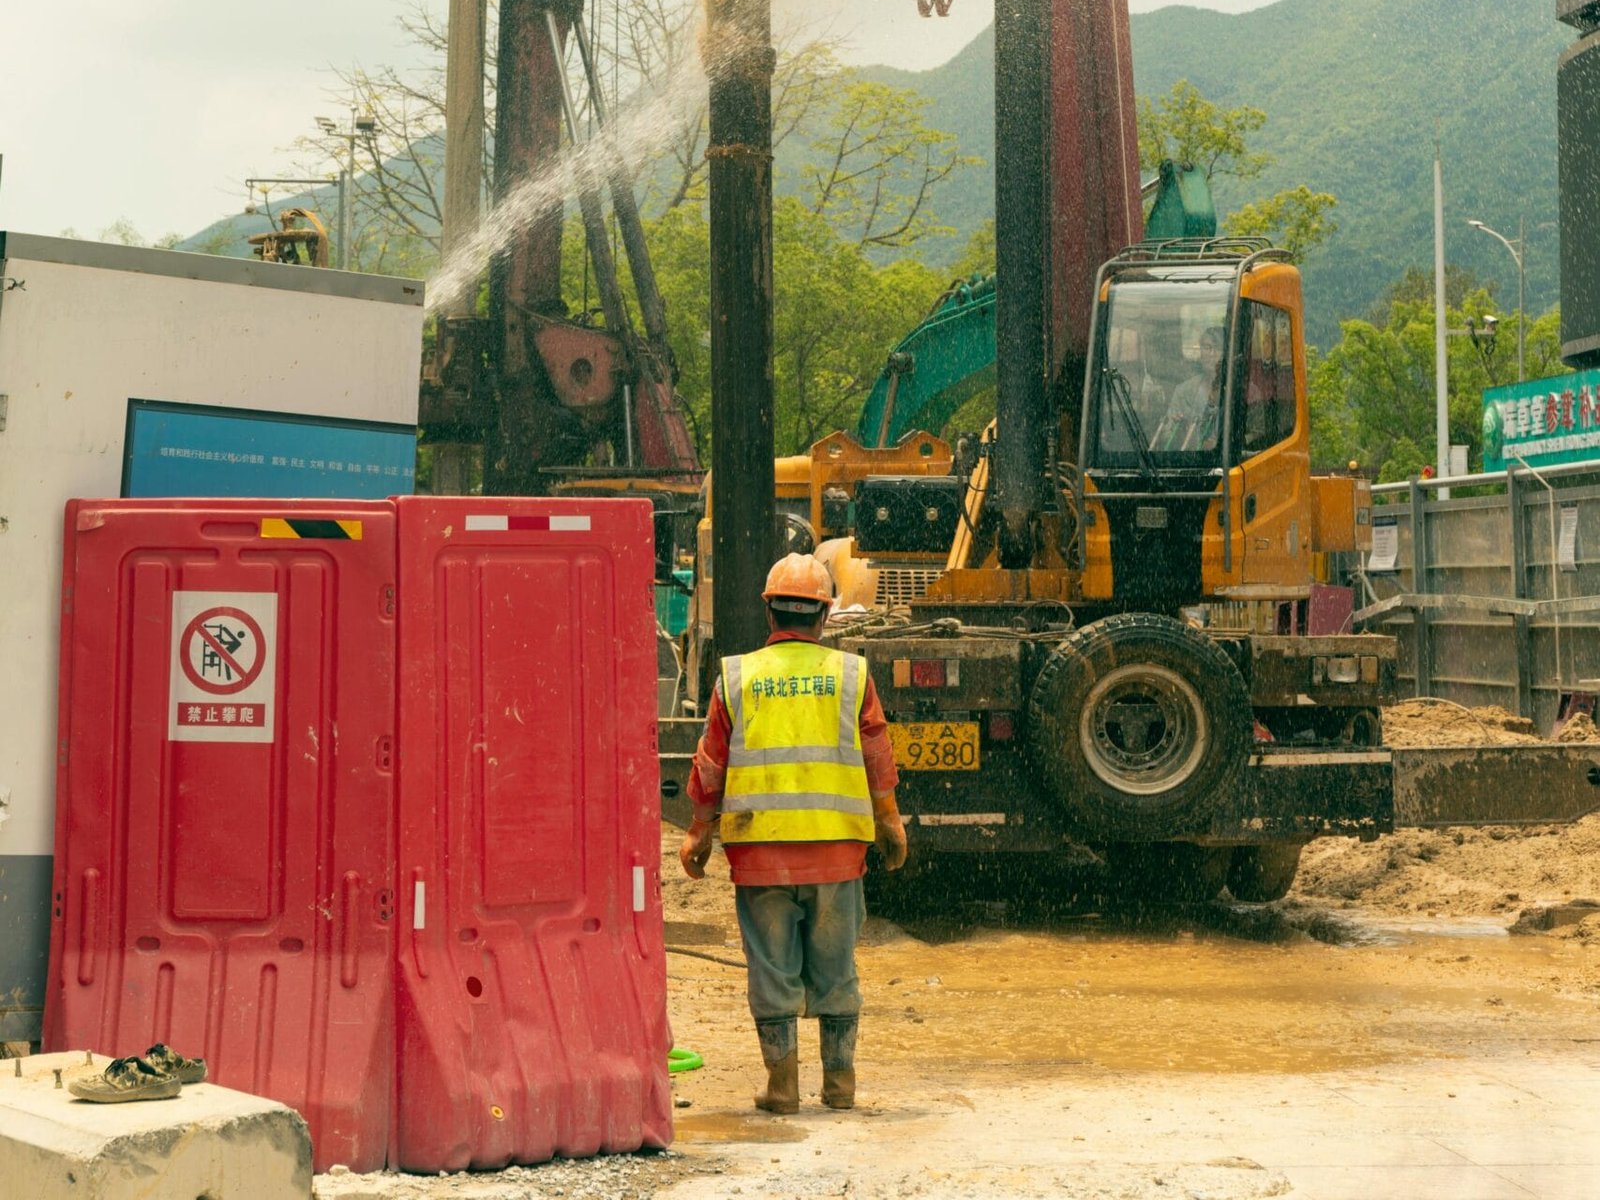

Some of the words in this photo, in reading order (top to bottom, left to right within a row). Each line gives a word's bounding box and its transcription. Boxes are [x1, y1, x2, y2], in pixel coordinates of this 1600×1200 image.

[752, 675, 836, 698] 中铁北京工程局
[187, 705, 254, 723] 禁止攀爬
